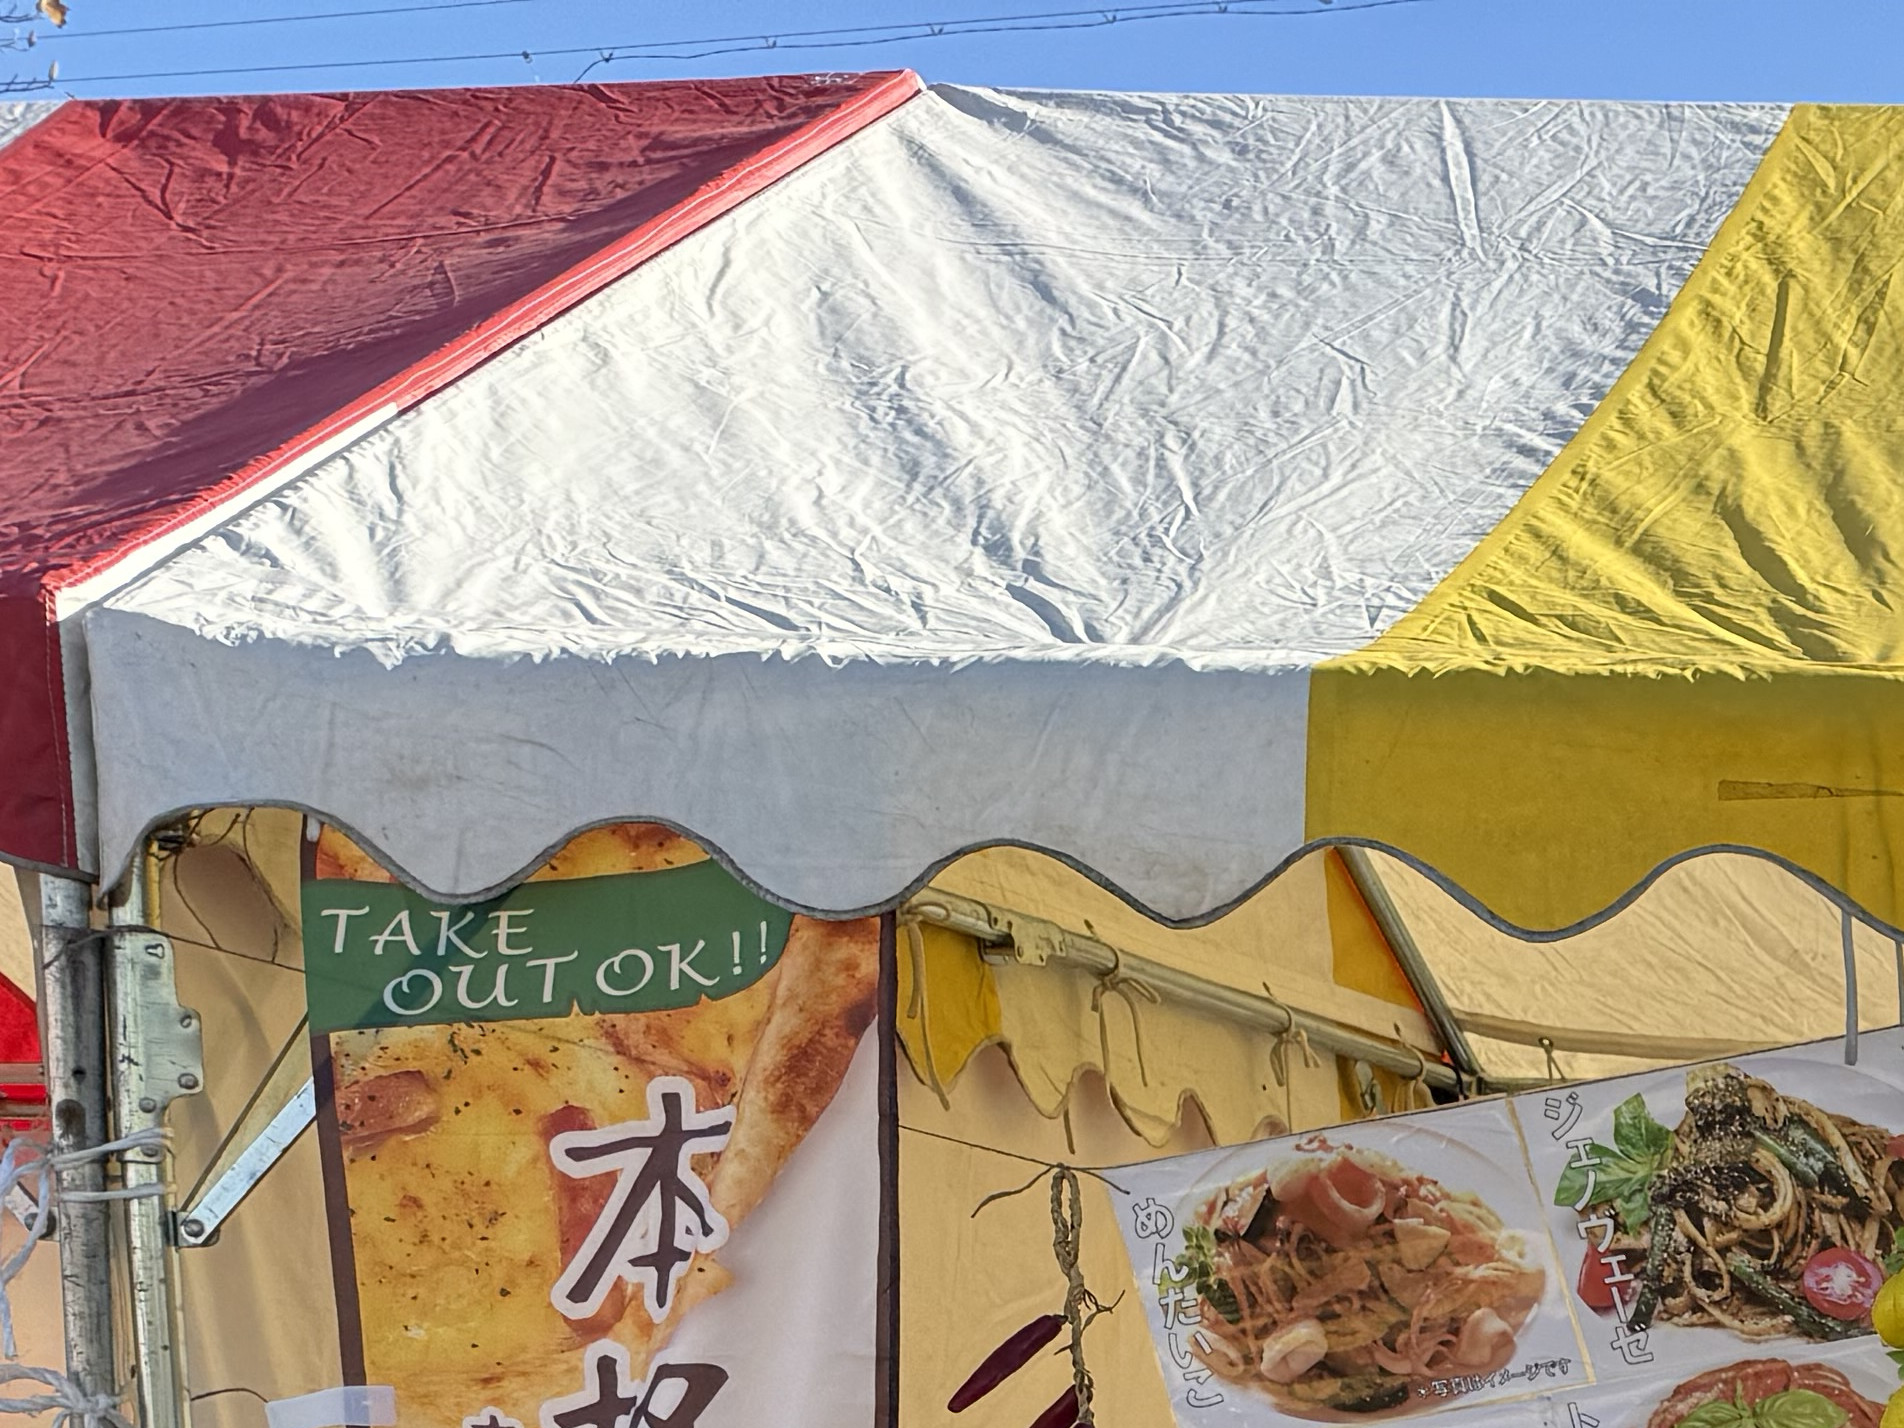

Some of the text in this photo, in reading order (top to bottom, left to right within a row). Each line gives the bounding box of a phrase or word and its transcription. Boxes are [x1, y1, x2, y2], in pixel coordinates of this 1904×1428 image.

[320, 906, 535, 958] TAKE
[383, 920, 775, 1016] OUT OK!!
[1131, 1197, 1225, 1409] めんたいこ
[1543, 1091, 1655, 1366] ジェノヴェーゼ
